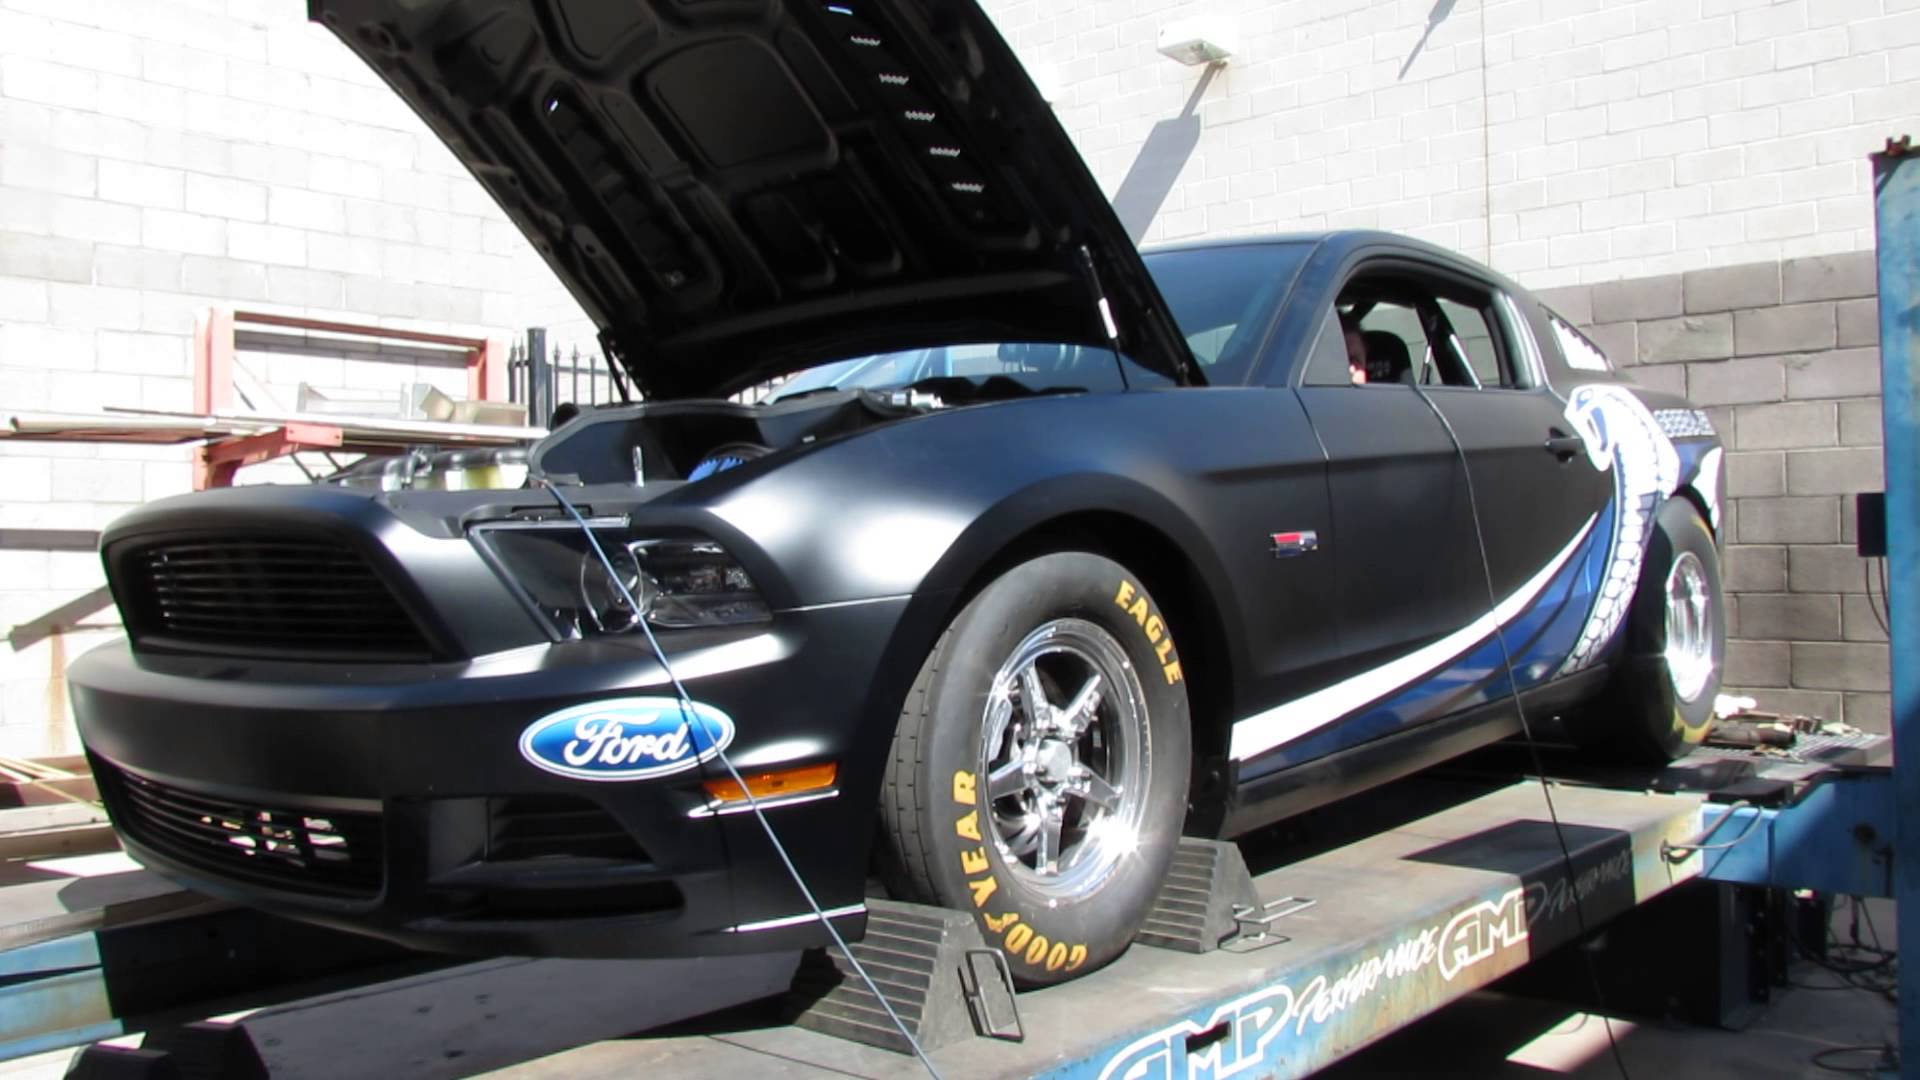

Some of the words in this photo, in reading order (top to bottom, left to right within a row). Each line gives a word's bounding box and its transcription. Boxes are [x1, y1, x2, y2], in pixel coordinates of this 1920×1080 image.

[1114, 580, 1184, 685] EAGLE
[564, 711, 693, 766] Ford
[1437, 881, 1548, 981] AMP
